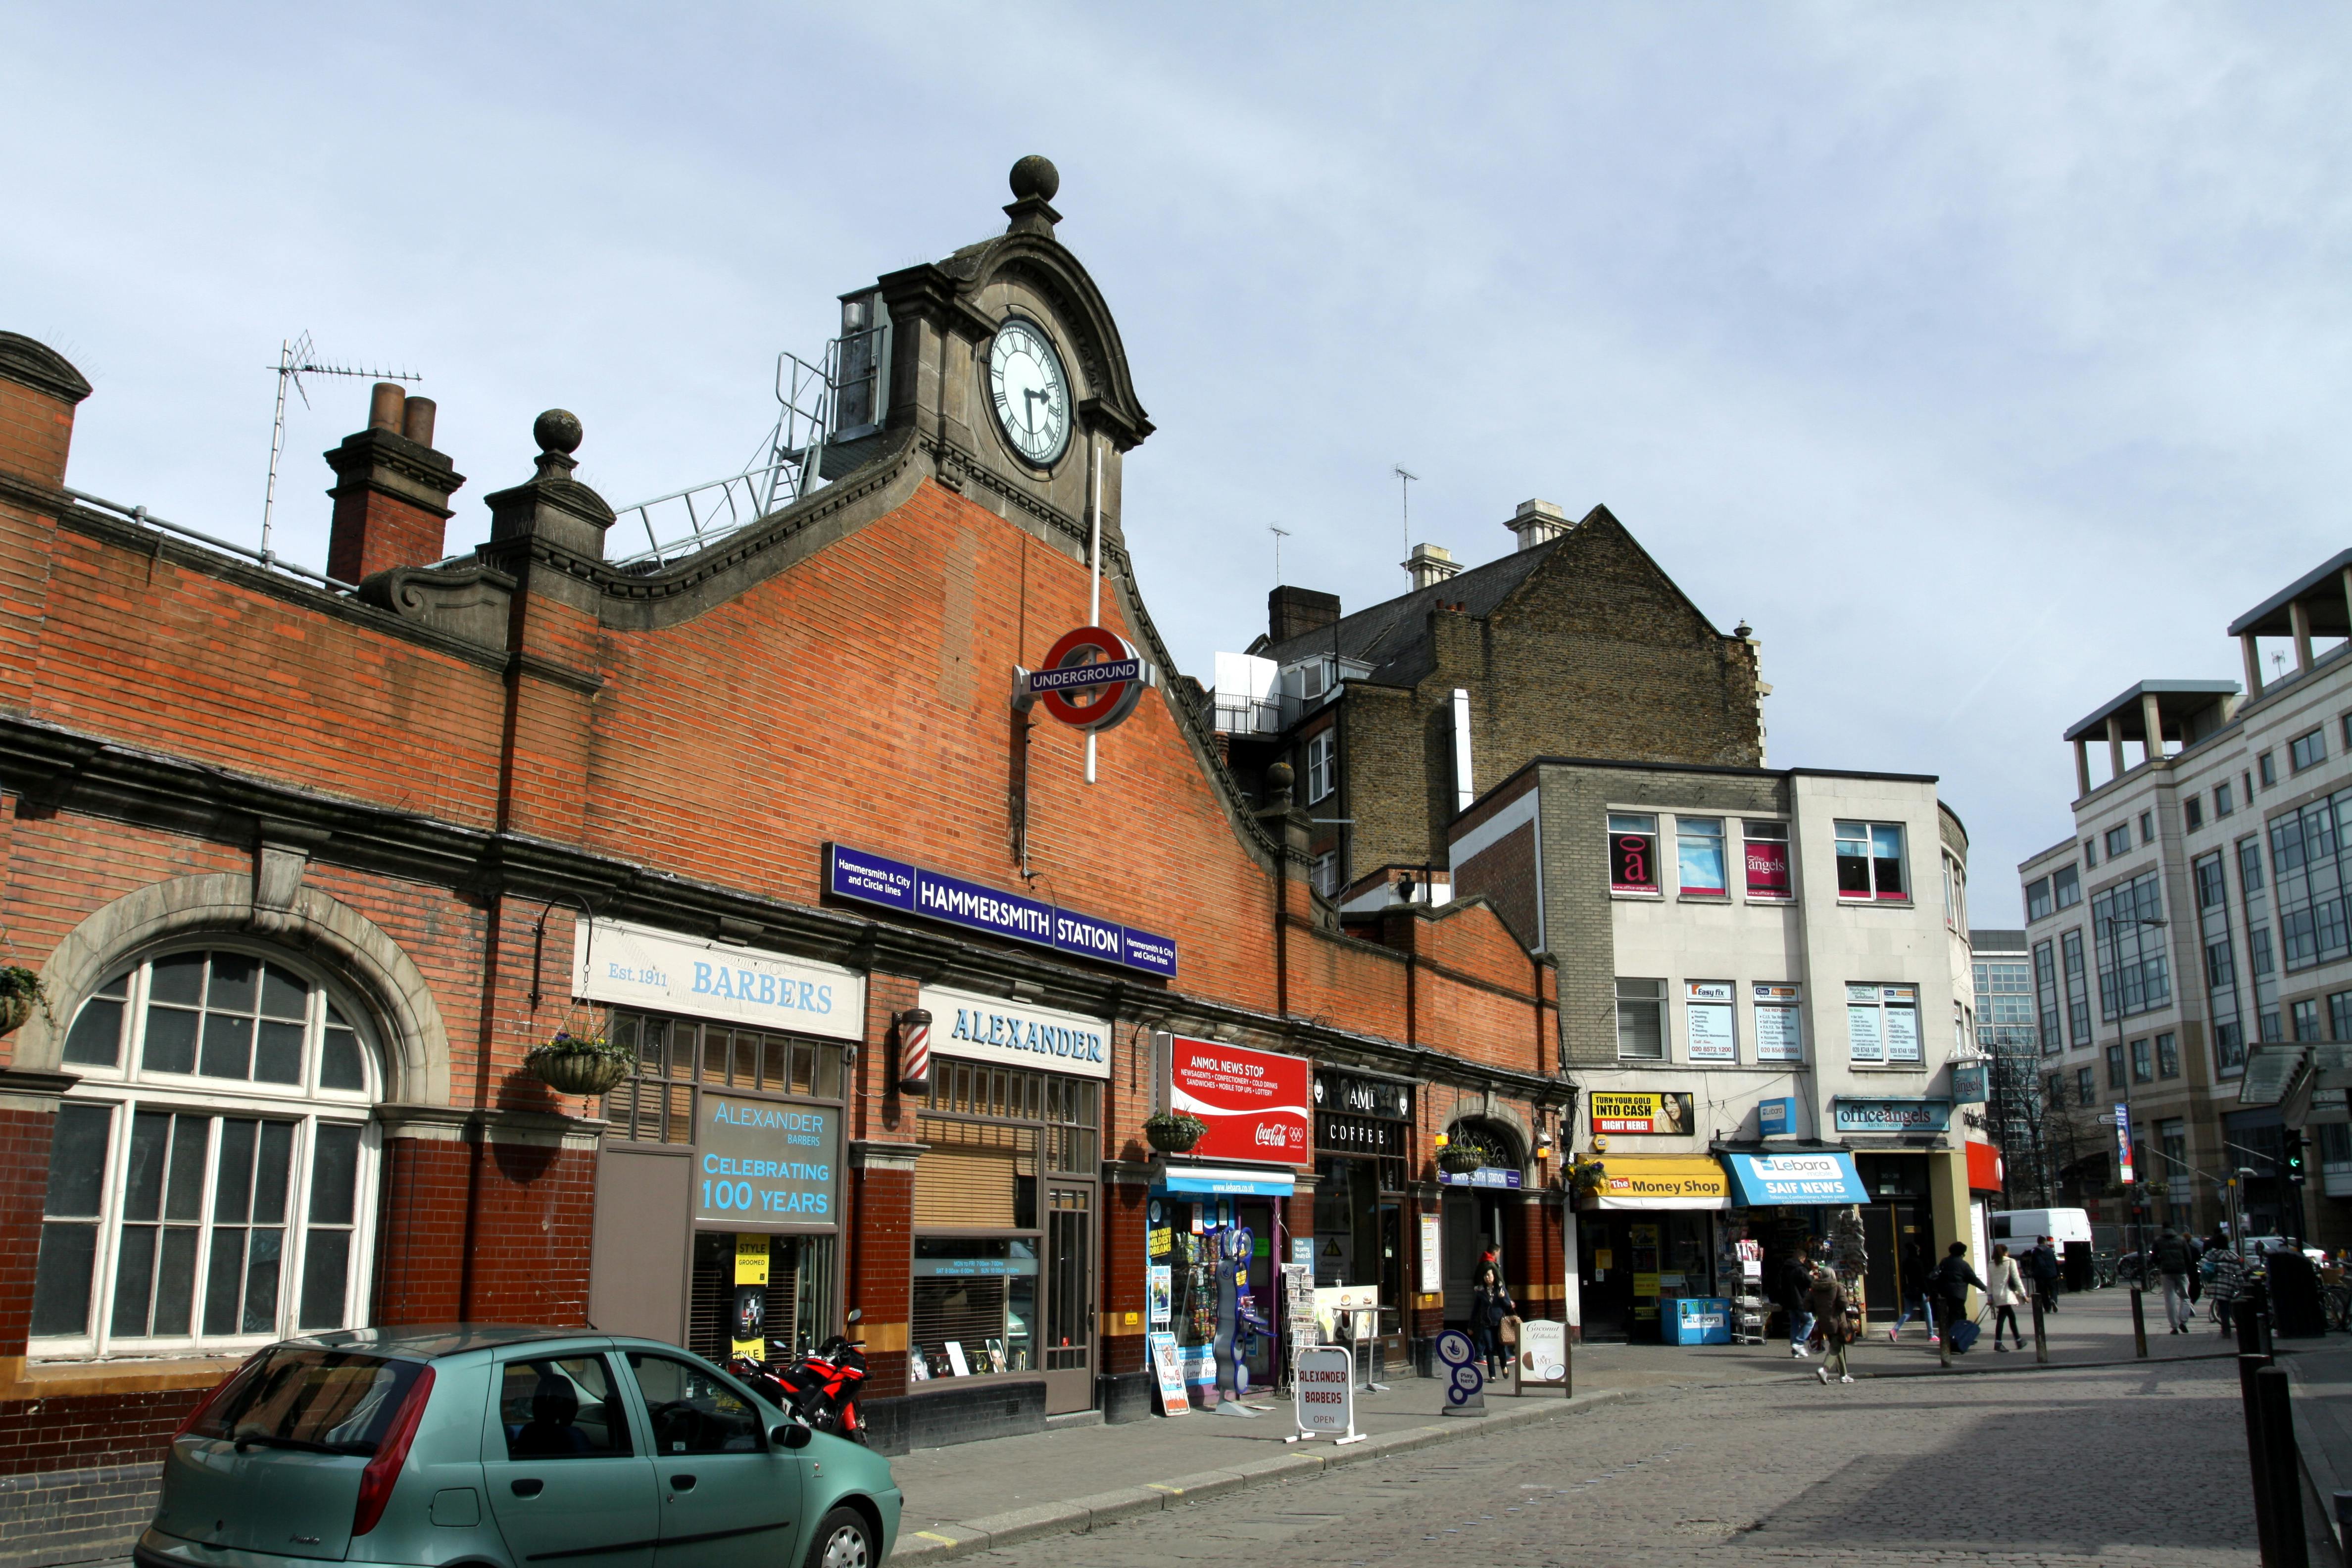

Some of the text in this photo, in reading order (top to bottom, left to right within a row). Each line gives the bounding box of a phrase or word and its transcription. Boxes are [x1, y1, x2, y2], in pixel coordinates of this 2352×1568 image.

[1033, 664, 1135, 687] UNDERGROUND
[839, 859, 911, 889] Hammersmith & City
[1748, 860, 1784, 874] angels
[848, 876, 901, 896] and Circle lines
[922, 881, 1118, 953] HAMMERSMITH STATION
[1127, 937, 1158, 953] Hammersmith
[1164, 948, 1173, 959] City
[1143, 952, 1156, 962] Circle
[1157, 955, 1168, 965] lines
[608, 961, 832, 1015] Est. 1911 BARBERS
[1698, 988, 1714, 997] Easy
[951, 1008, 1104, 1063] ALEXANDER
[1191, 1056, 1264, 1078] ANMOL NEWS STOP
[1181, 1069, 1211, 1079] NEWSAGENTS
[1215, 1074, 1248, 1085] CONFECTIONERY
[1186, 1078, 1215, 1088] SANDWICHES
[1219, 1082, 1234, 1091] MOBILE
[1255, 1088, 1273, 1096] LOTTERY
[1956, 1077, 1983, 1096] angels
[1350, 1084, 1375, 1110] AMT
[714, 1102, 823, 1132] ALEXANDER
[1596, 1105, 1651, 1116] INTO CASH
[1602, 1120, 1648, 1130] RIGHT HERE!
[788, 1133, 820, 1146] BARBERS
[1330, 1125, 1384, 1144] COFFEE
[704, 1154, 829, 1181] CELEBRATING
[1773, 1160, 1830, 1171] Lebara
[1488, 1173, 1505, 1183] STATION
[1213, 1182, 1255, 1193] www.lebara.co.uk
[1611, 1180, 1720, 1195] The Money Shop
[1765, 1181, 1845, 1193] SAIF NEWS
[703, 1180, 828, 1213] 100 YEARS
[1158, 1227, 1171, 1236] YOUR
[739, 1243, 766, 1253] STYLE
[1149, 1243, 1171, 1256] DREAMS
[1526, 1323, 1559, 1332] Coconut
[1300, 1371, 1346, 1383] ALEXANDER
[1305, 1391, 1342, 1404] BARBERS
